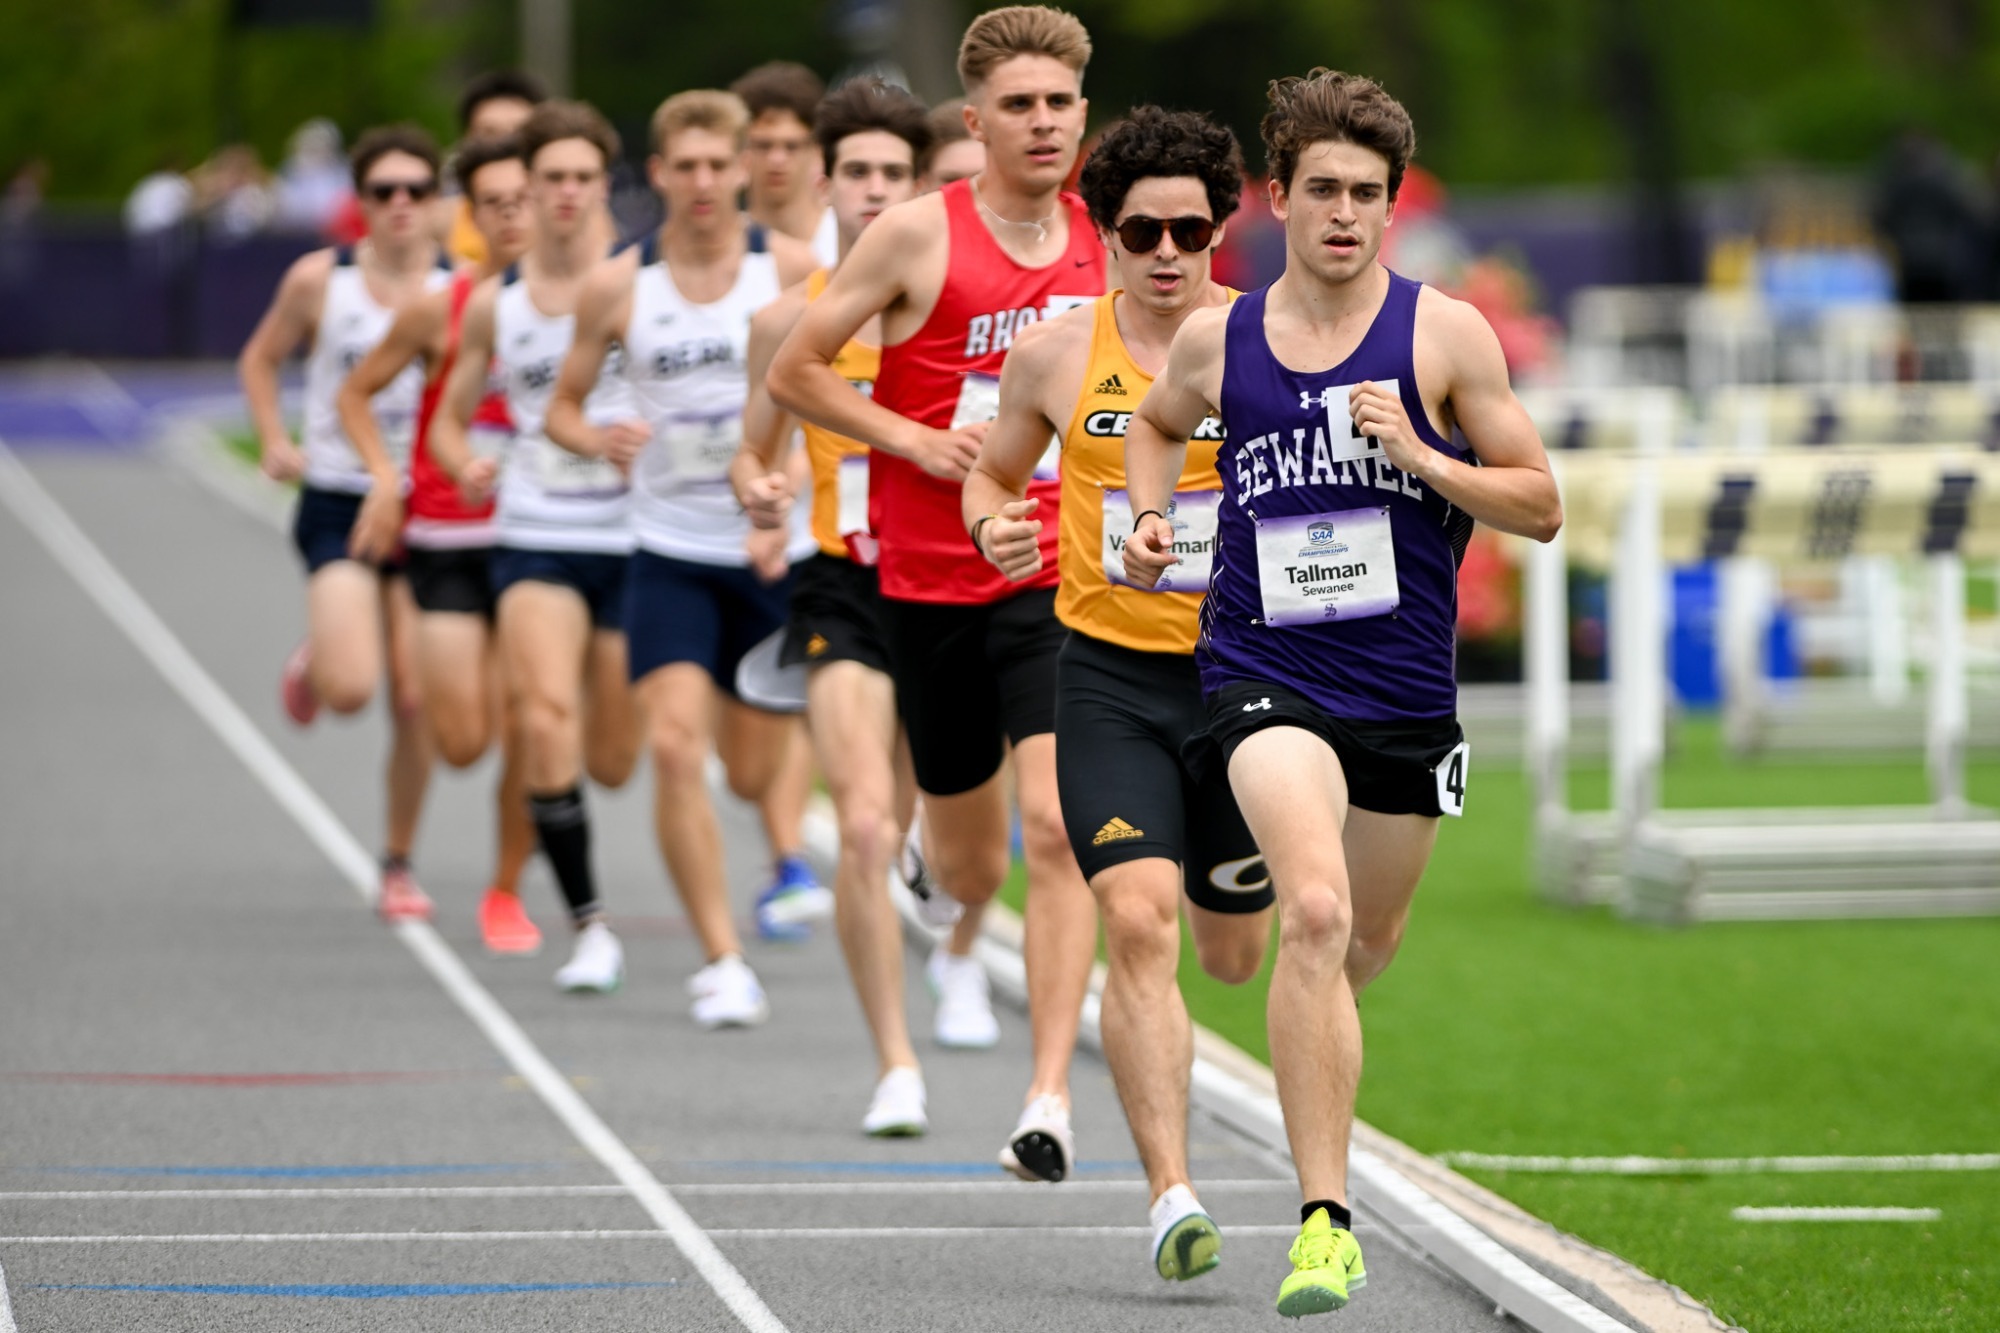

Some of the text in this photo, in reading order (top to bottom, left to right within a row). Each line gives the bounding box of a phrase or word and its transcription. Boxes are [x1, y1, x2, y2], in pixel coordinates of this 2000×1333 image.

[964, 306, 1049, 358] RHO
[1094, 386, 1128, 396] adidas
[1311, 530, 1333, 541] SAA
[1298, 546, 1349, 558] CHAMPIONSHIPS
[1284, 562, 1367, 584] Tallman
[1302, 582, 1355, 597] Sewanee
[1446, 750, 1465, 807] 4
[1092, 829, 1145, 846] adidas
